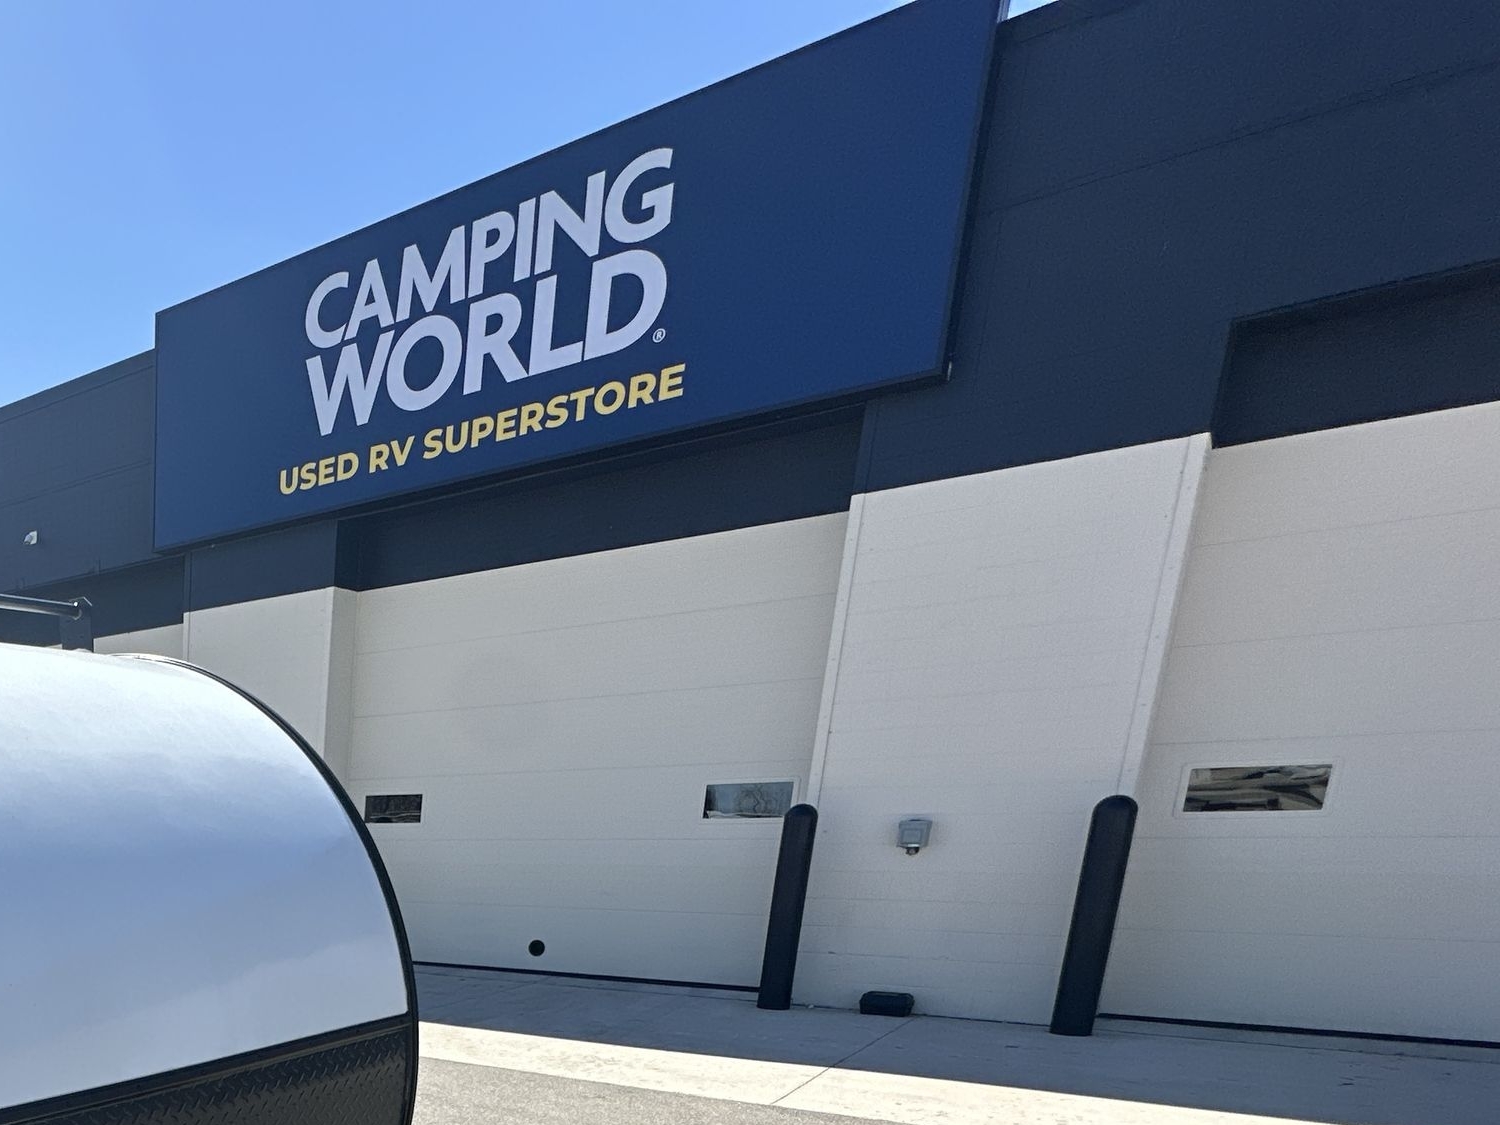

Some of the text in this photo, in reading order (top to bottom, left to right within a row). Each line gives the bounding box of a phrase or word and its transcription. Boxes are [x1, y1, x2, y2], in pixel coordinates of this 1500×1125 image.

[305, 147, 674, 349] CAMPING
[278, 362, 687, 495] USED RV SUPERSTORE
